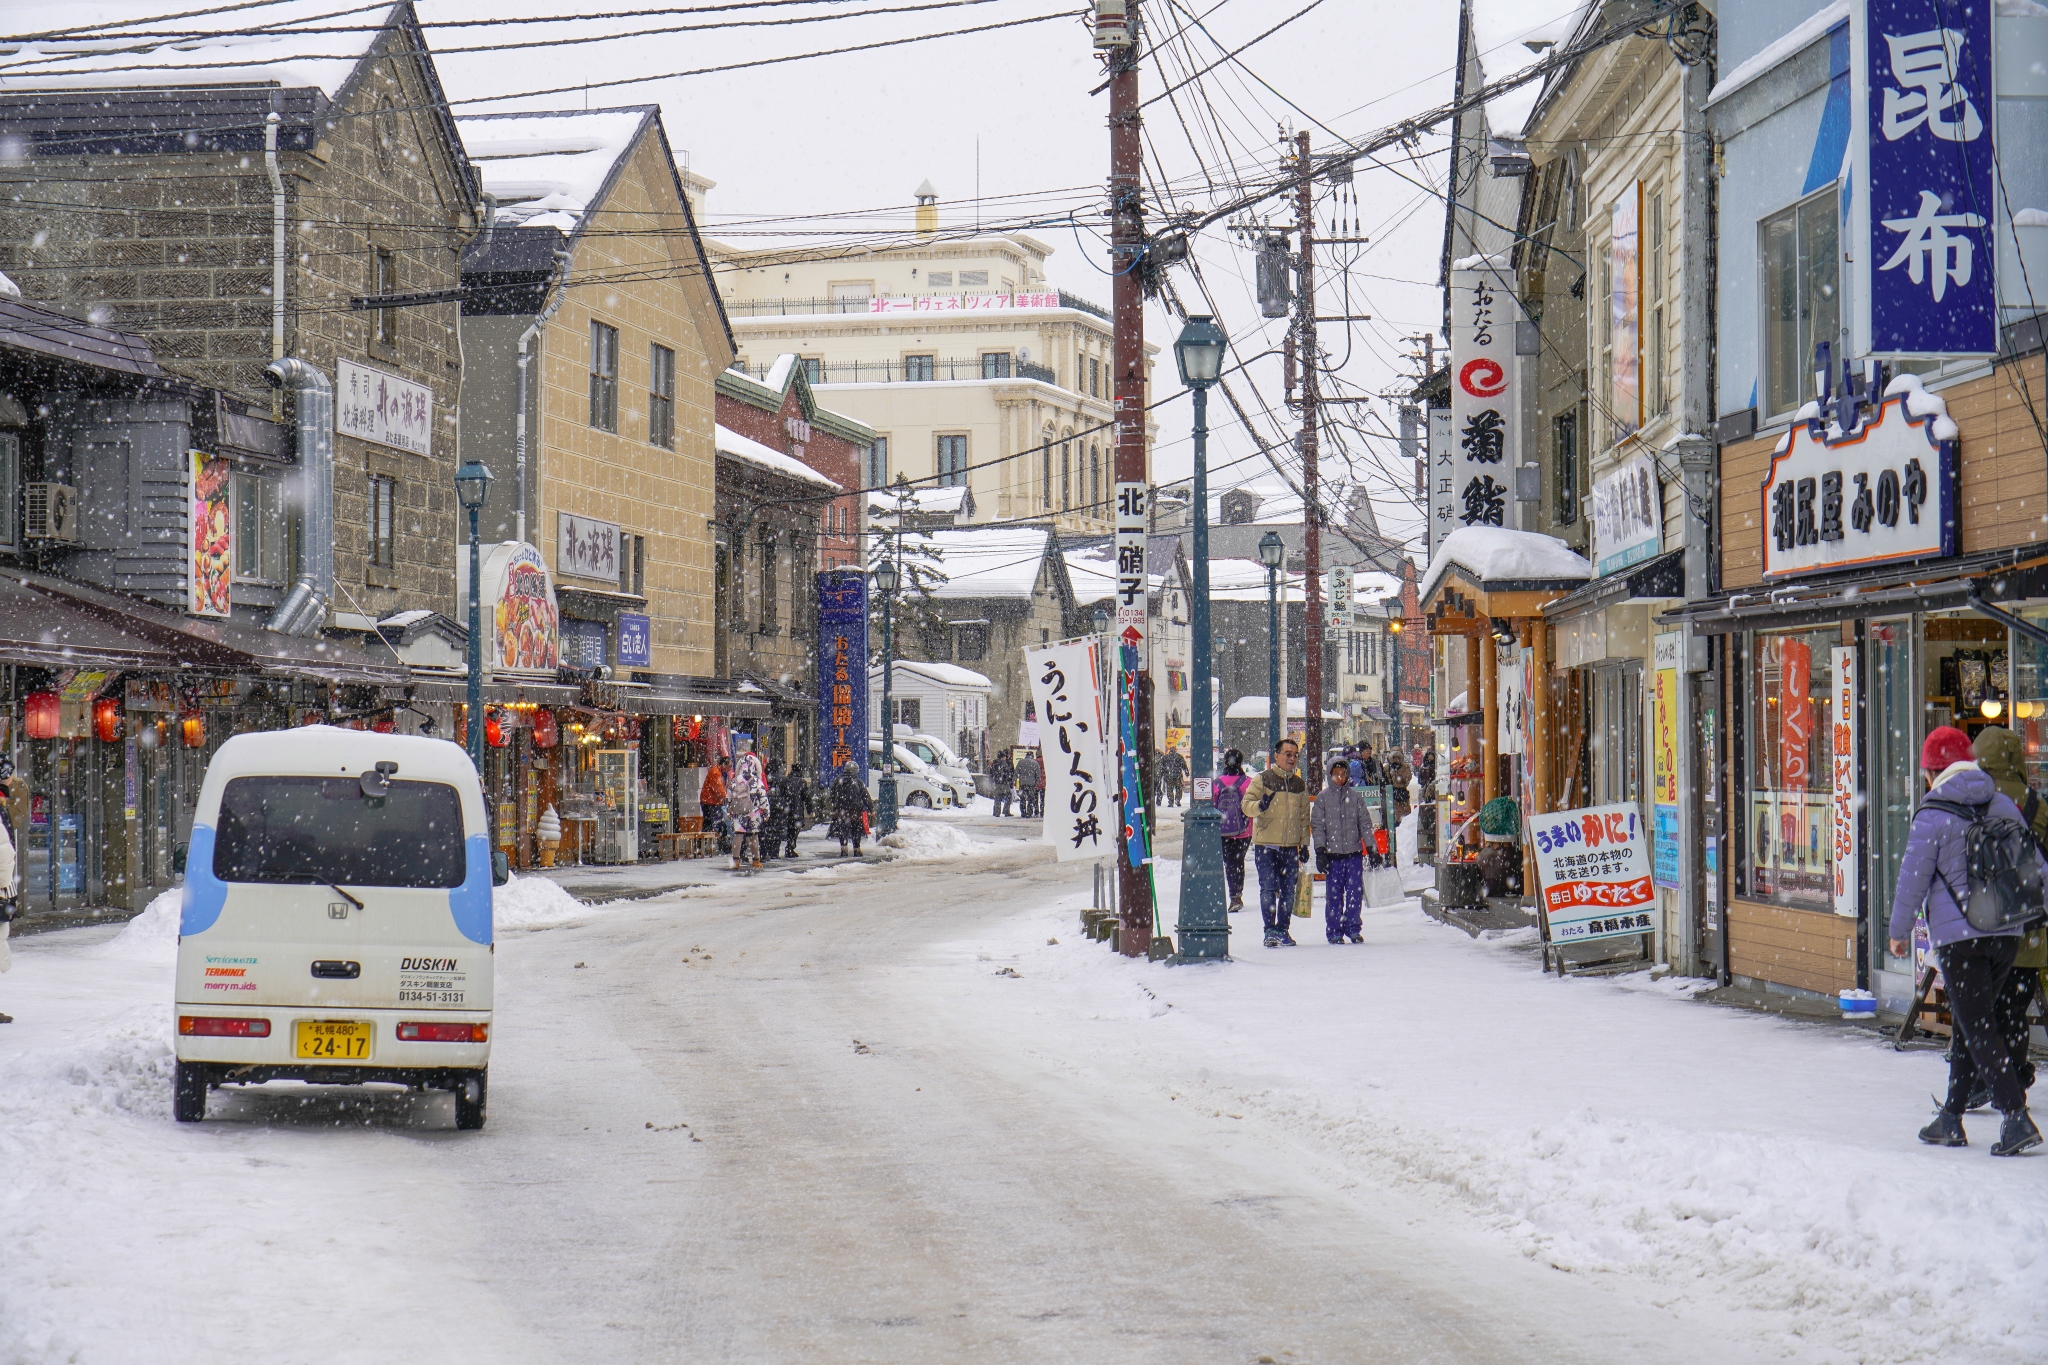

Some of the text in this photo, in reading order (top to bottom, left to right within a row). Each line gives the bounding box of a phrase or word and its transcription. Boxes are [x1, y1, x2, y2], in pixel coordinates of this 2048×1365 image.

[1879, 27, 1986, 303] 昆布
[1472, 281, 1495, 347] おたる
[350, 369, 370, 399] 寿司
[343, 402, 375, 434] 北海料理
[377, 375, 427, 438] 北の漁場
[1459, 408, 1508, 528] 菊鮨
[1772, 457, 1927, 551] 利尻屋 みのや
[565, 517, 614, 575] 北の漁場
[1118, 487, 1145, 606] 北一硝子
[621, 629, 647, 655] 白い恋人
[1041, 660, 1102, 849] うにいくら丼
[1553, 847, 1633, 869] 北海道の本物の
[1554, 861, 1630, 881] 味を送ります。
[1561, 913, 1651, 937] おたる 高橋水産
[204, 982, 229, 991] merry
[205, 968, 246, 977] TERMINIX
[399, 990, 464, 1002] 0134-51-3131
[313, 1037, 366, 1056] 24-17
